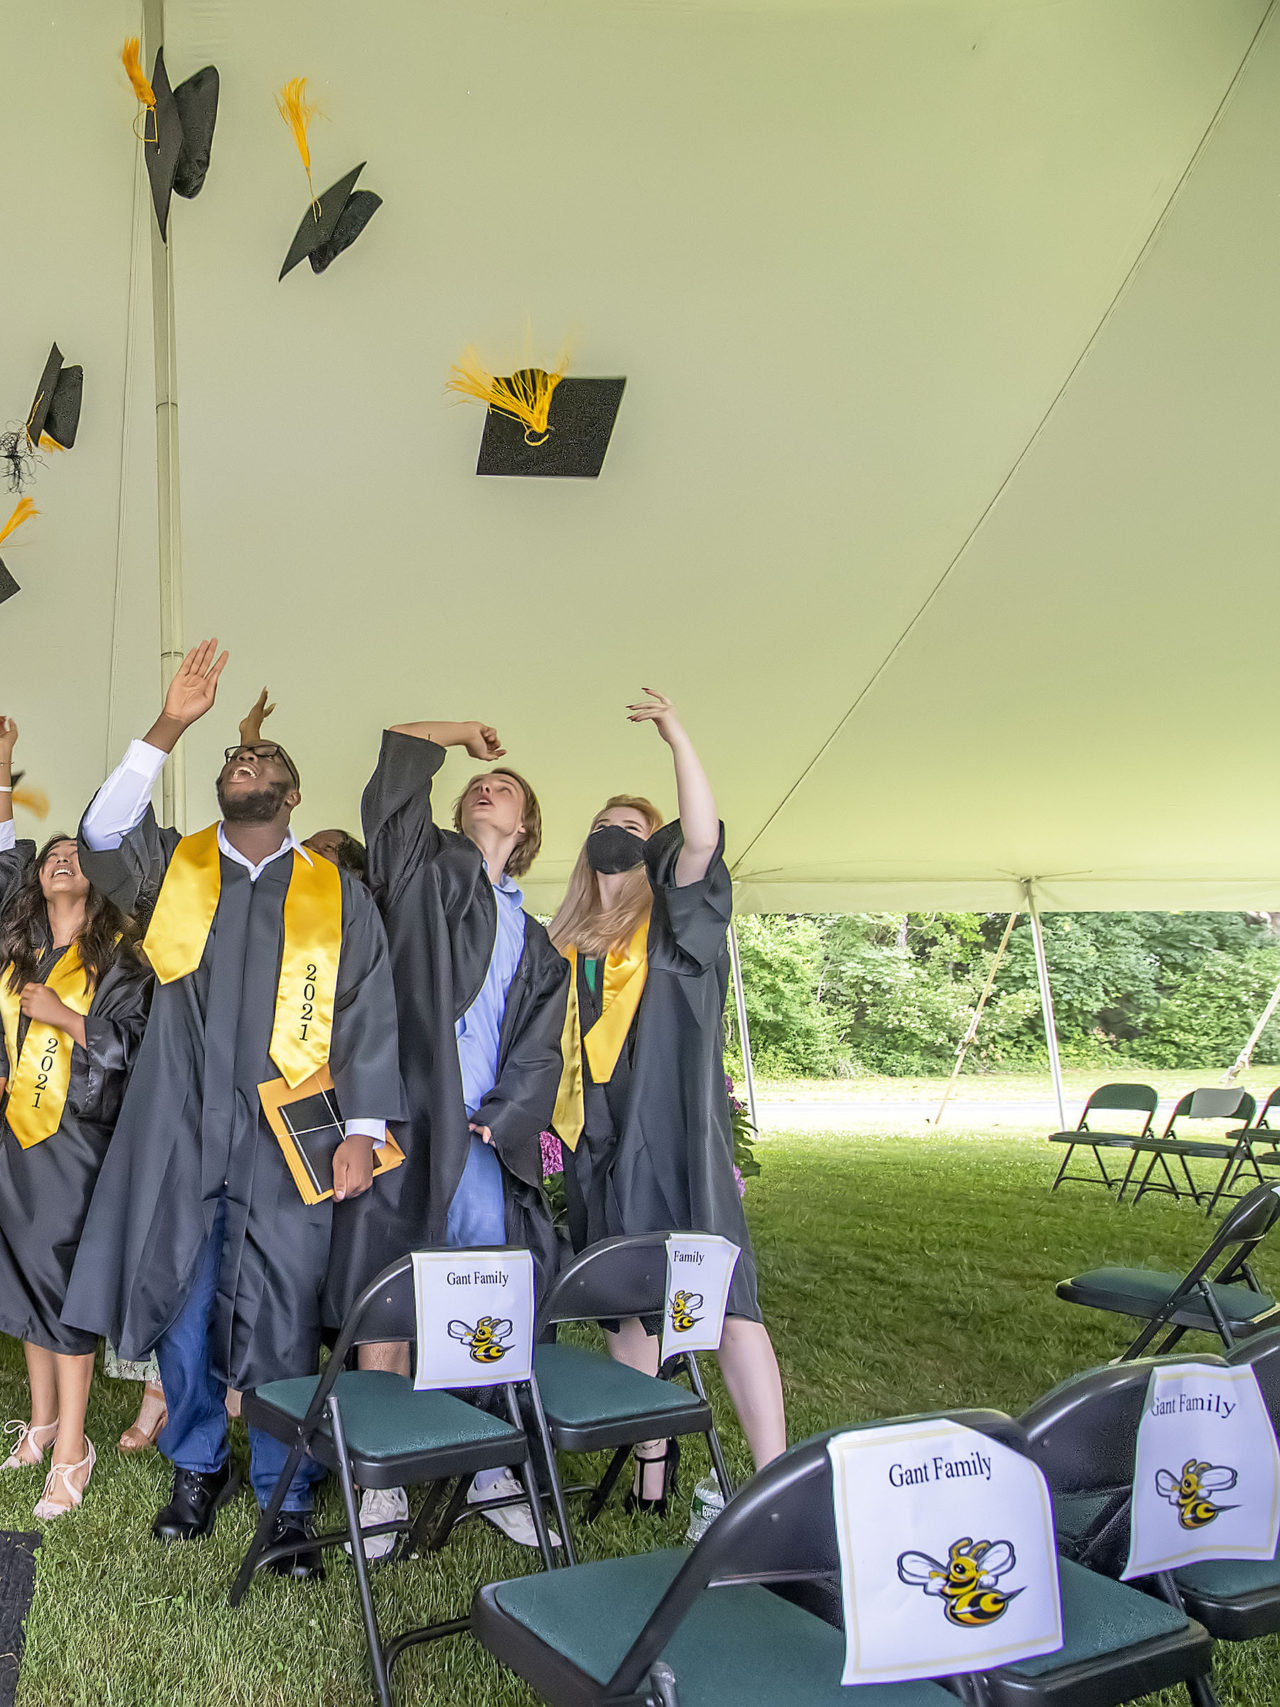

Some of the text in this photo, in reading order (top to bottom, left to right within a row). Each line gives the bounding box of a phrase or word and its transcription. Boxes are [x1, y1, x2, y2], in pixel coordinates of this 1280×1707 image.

[298, 963, 318, 1042] 2021
[31, 1037, 59, 1109] 2021
[673, 1250, 706, 1265] Family
[446, 1270, 510, 1288] Gant Family
[1179, 1393, 1237, 1419] Family
[888, 1451, 991, 1488] Gant Family
